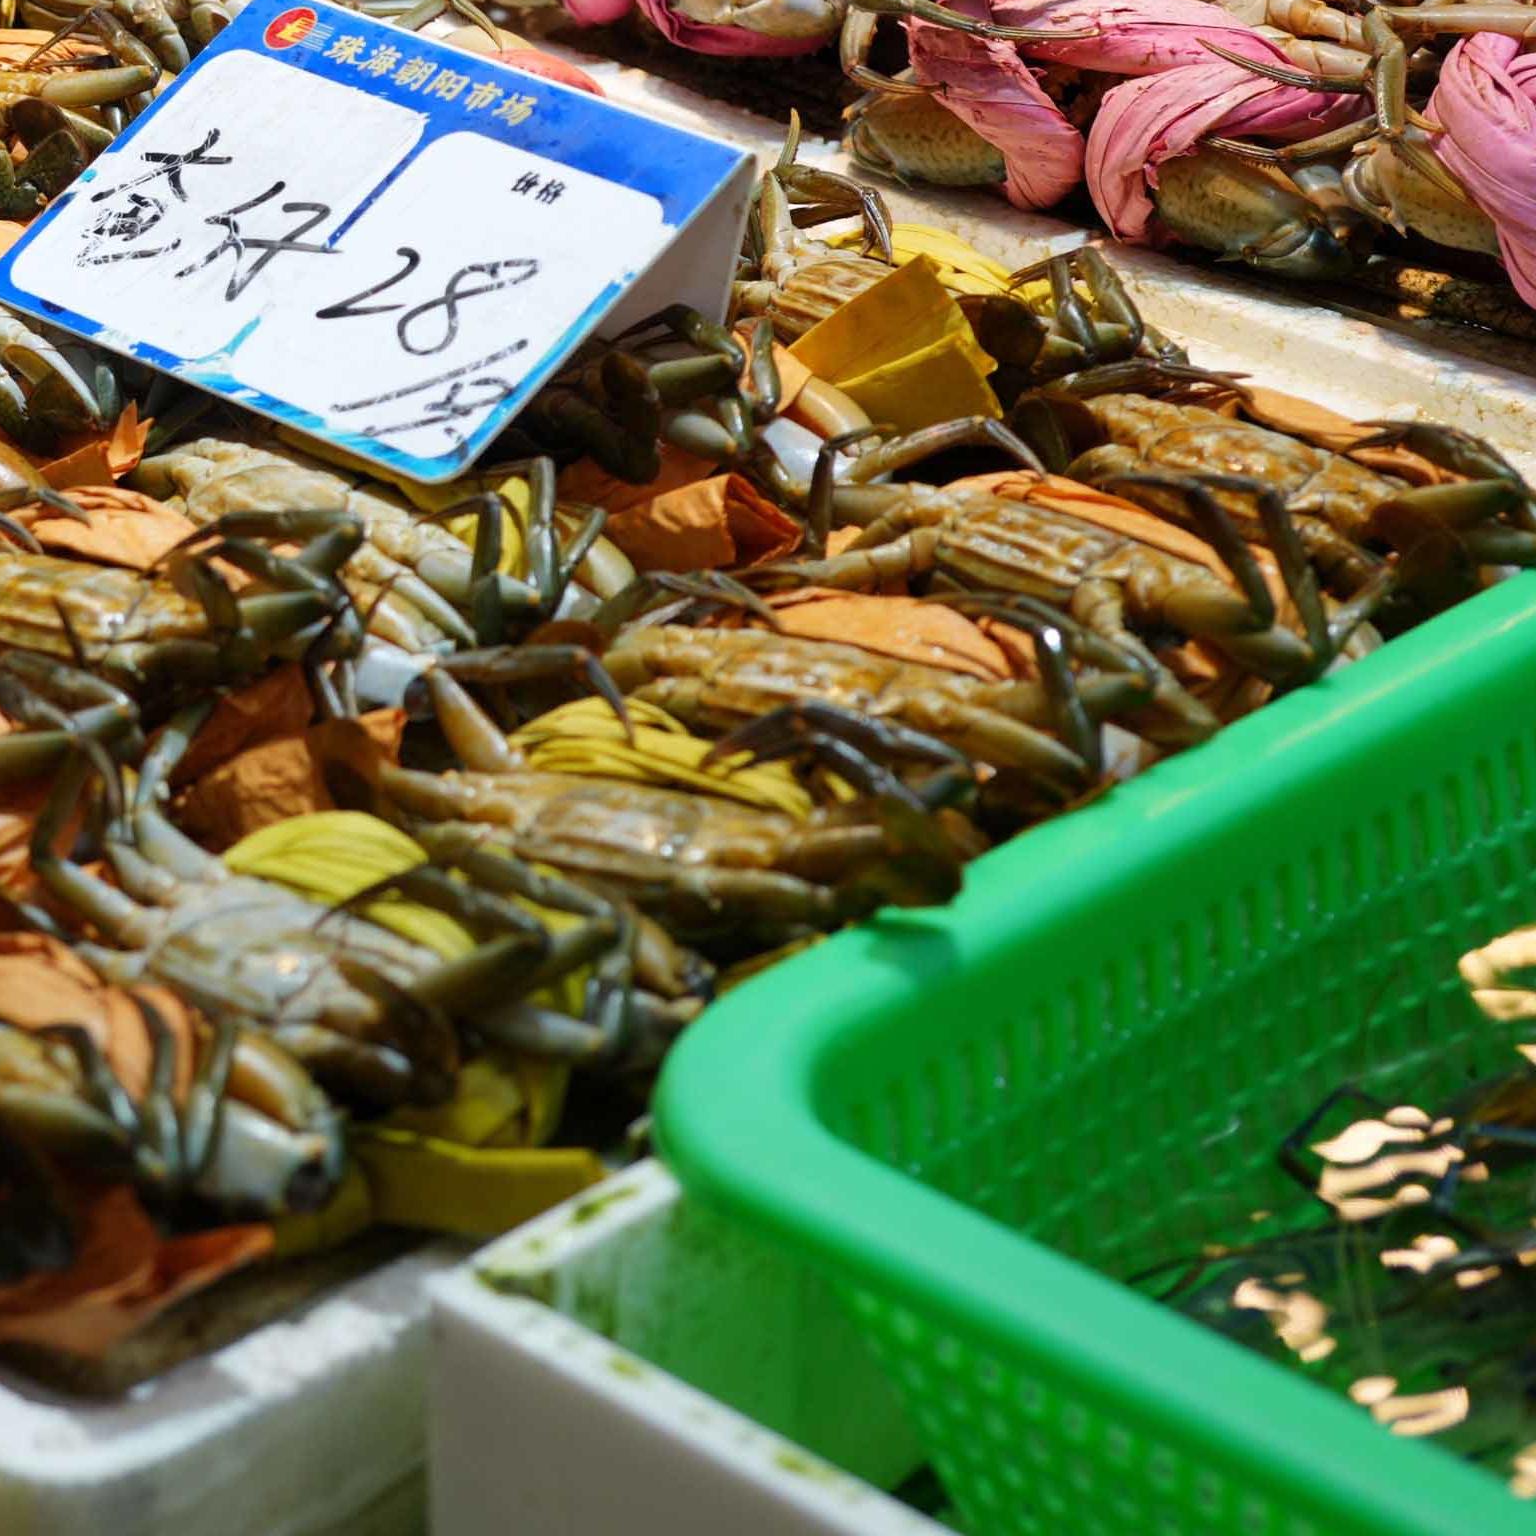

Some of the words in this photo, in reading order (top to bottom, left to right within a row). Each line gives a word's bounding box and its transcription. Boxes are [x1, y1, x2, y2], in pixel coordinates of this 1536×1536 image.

[322, 34, 539, 127] 珠海朝阳市场
[510, 170, 568, 206] 价格
[315, 247, 541, 356] 28
